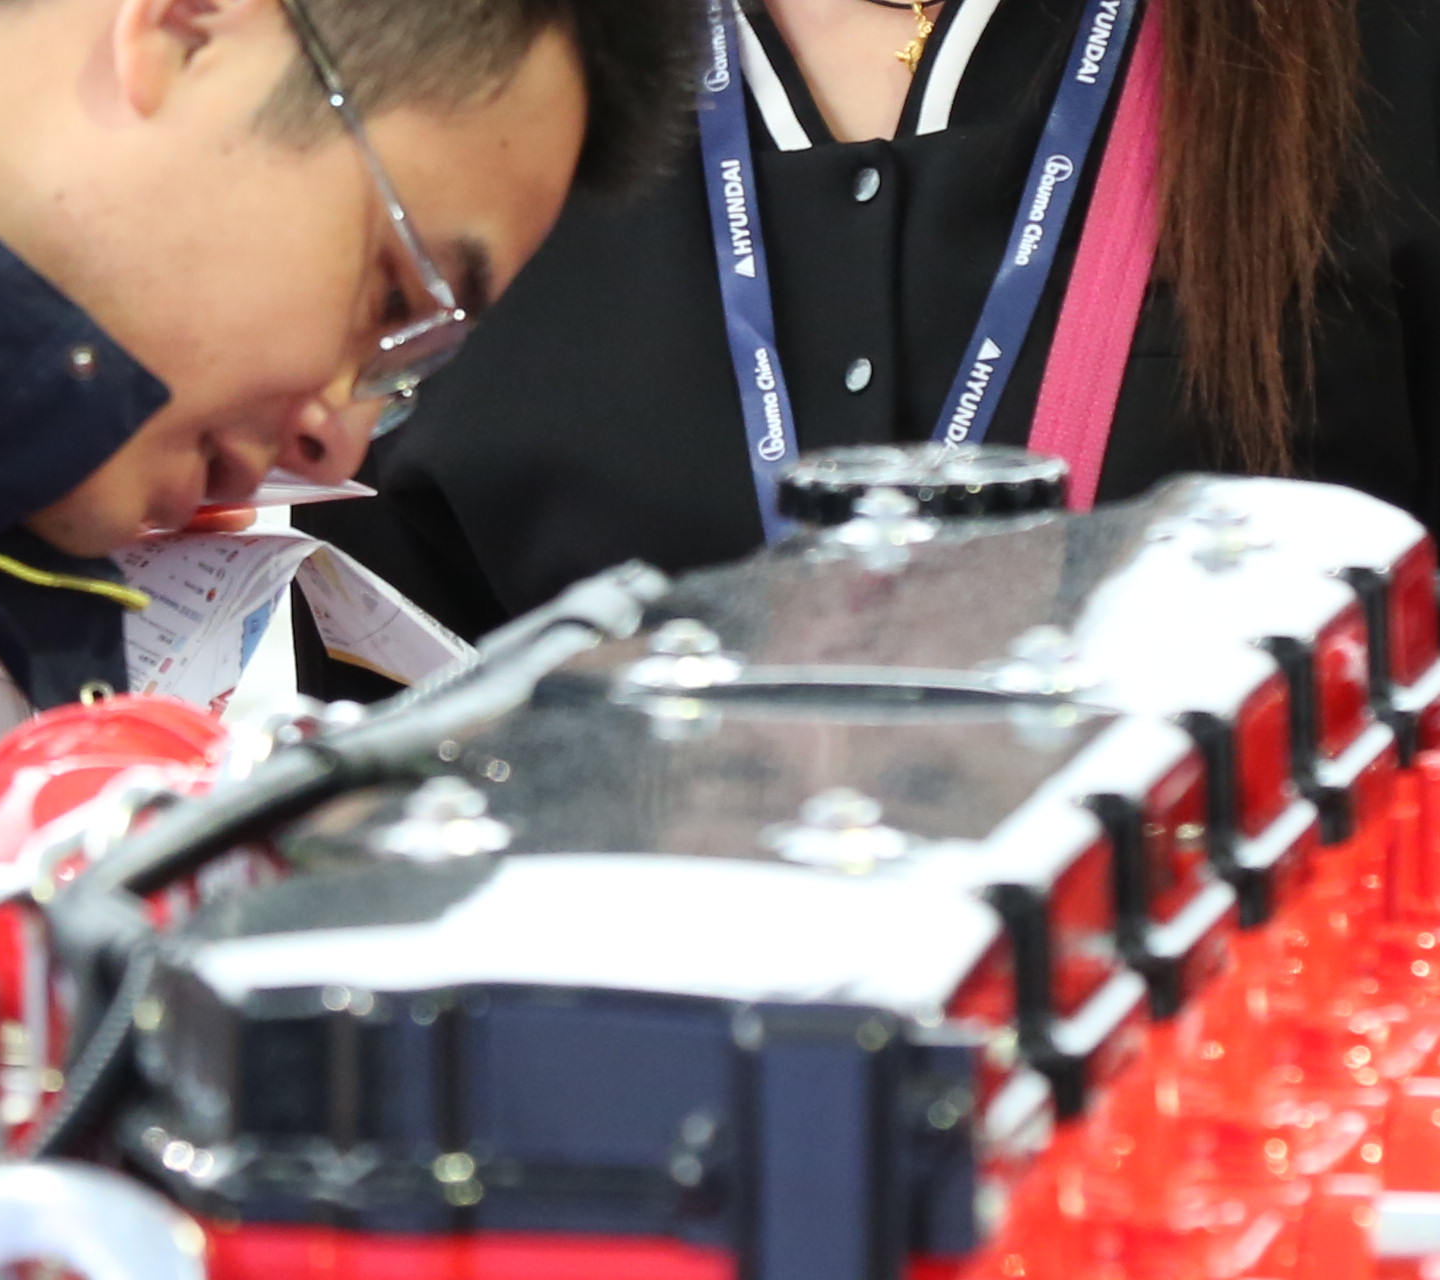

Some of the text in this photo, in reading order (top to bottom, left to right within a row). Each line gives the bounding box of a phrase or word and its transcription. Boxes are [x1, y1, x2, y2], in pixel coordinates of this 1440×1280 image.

[720, 159, 753, 256] HYUNDAI
[1015, 154, 1073, 266] bauma China
[754, 348, 786, 462] bauma China
[943, 361, 994, 452] HYUNDA
